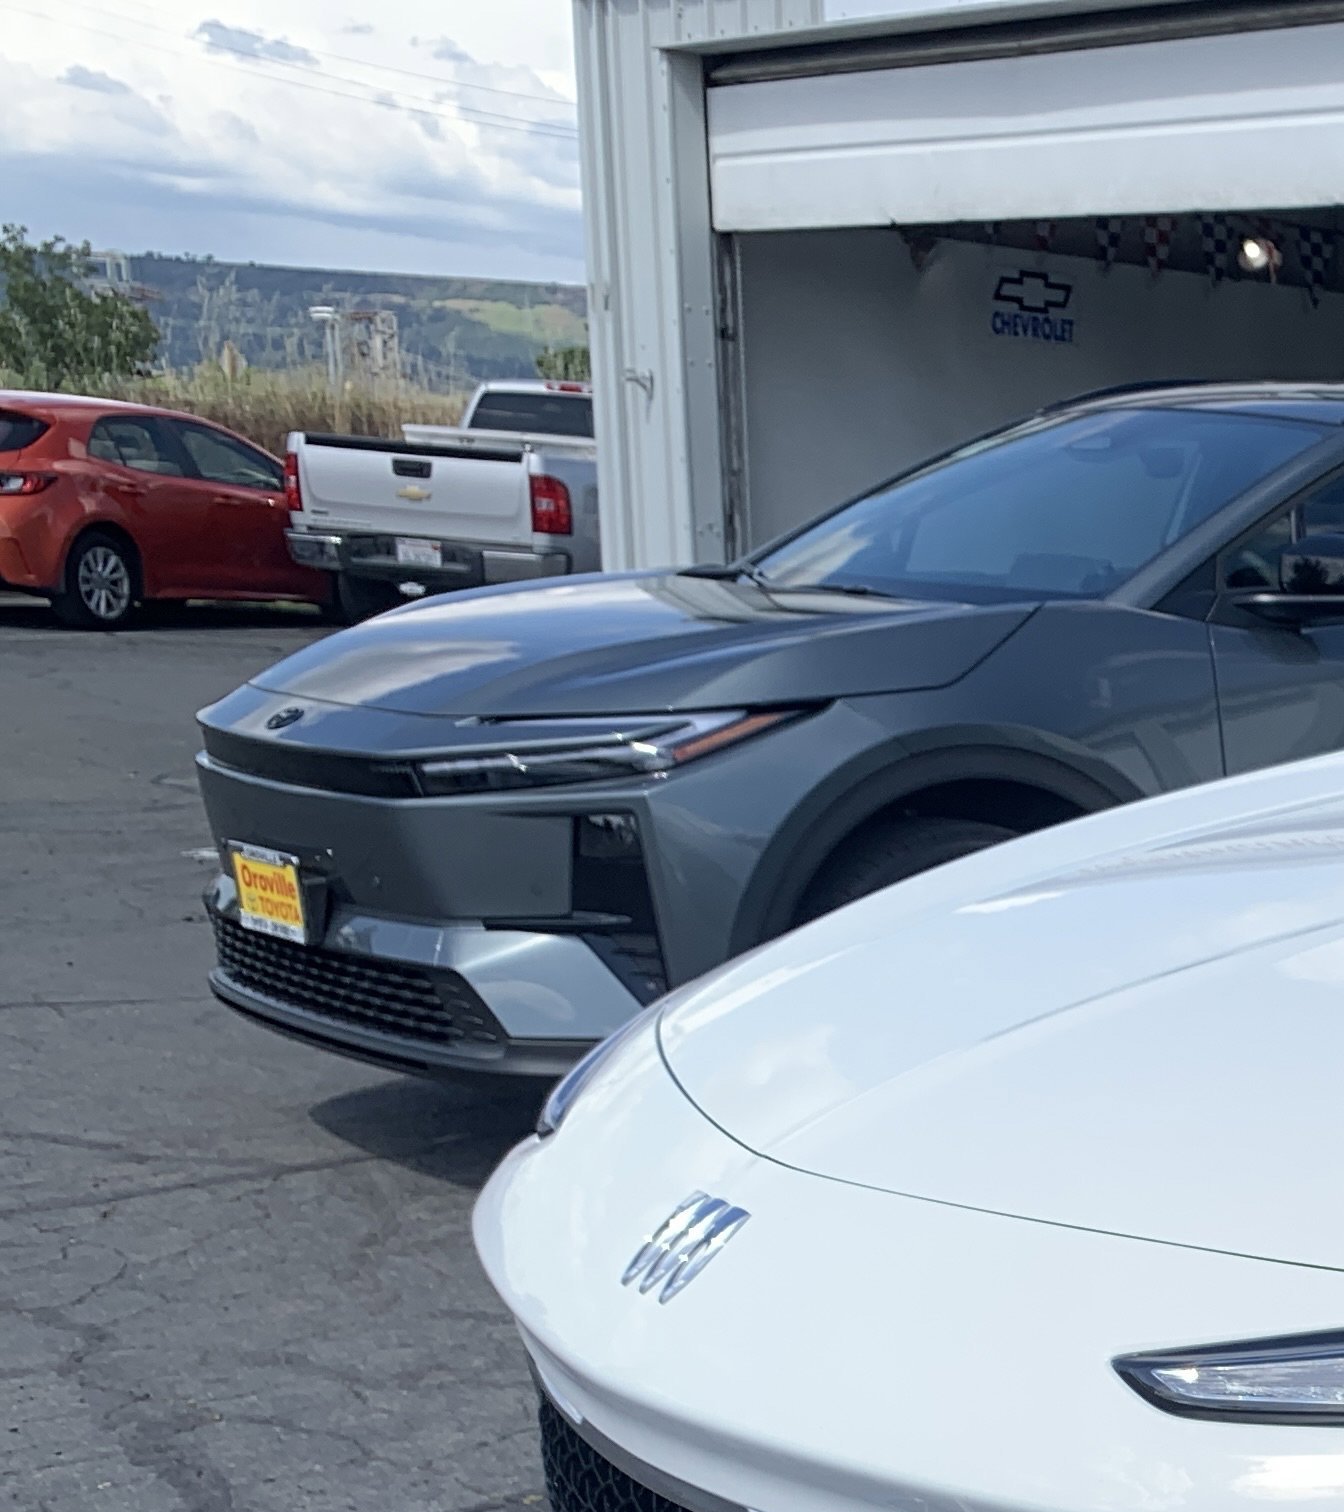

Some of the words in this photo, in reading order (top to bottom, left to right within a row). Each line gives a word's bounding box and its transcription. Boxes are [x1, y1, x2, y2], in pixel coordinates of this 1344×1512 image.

[992, 311, 1074, 342] CHEVROLET
[241, 864, 296, 899] Oroville
[258, 895, 302, 925] TOYOTA
